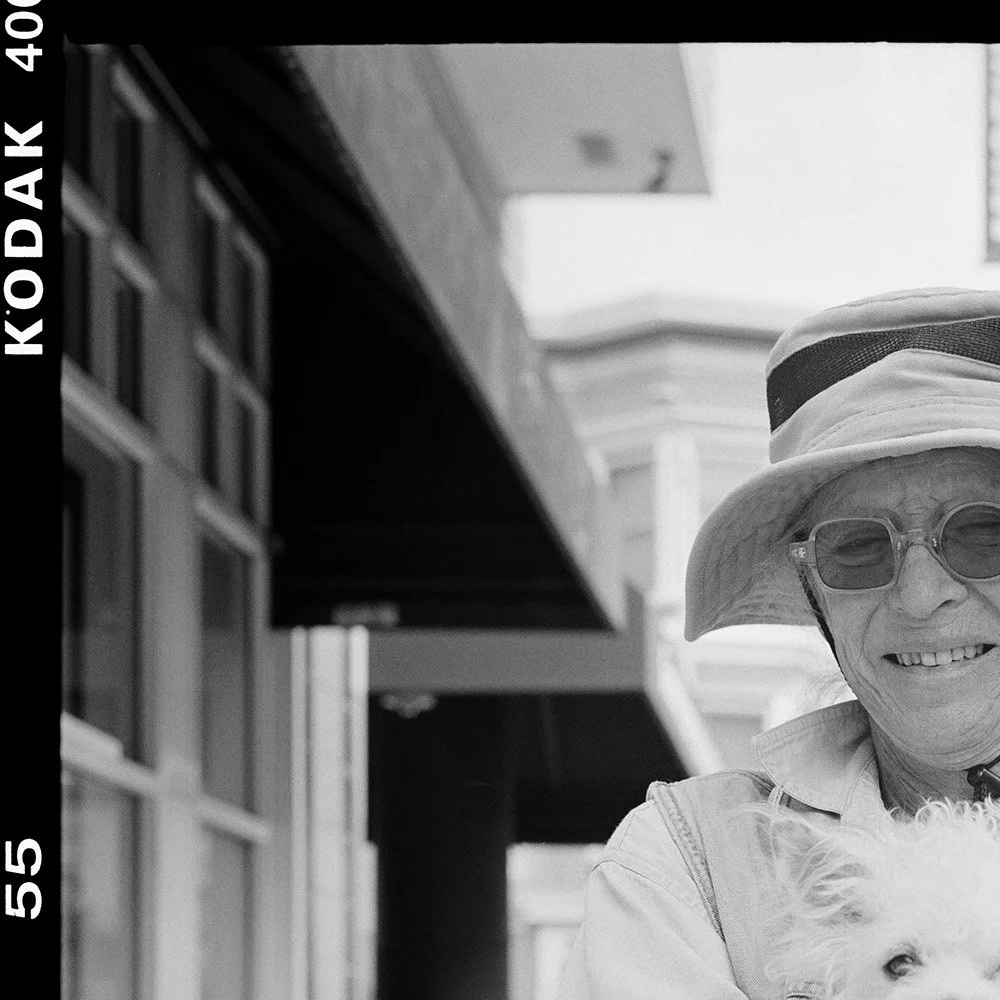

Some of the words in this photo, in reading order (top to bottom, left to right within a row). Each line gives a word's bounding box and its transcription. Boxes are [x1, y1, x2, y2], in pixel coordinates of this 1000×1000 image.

[5, 0, 43, 72] 40
[4, 121, 43, 356] KODAK
[5, 839, 42, 919] 55
